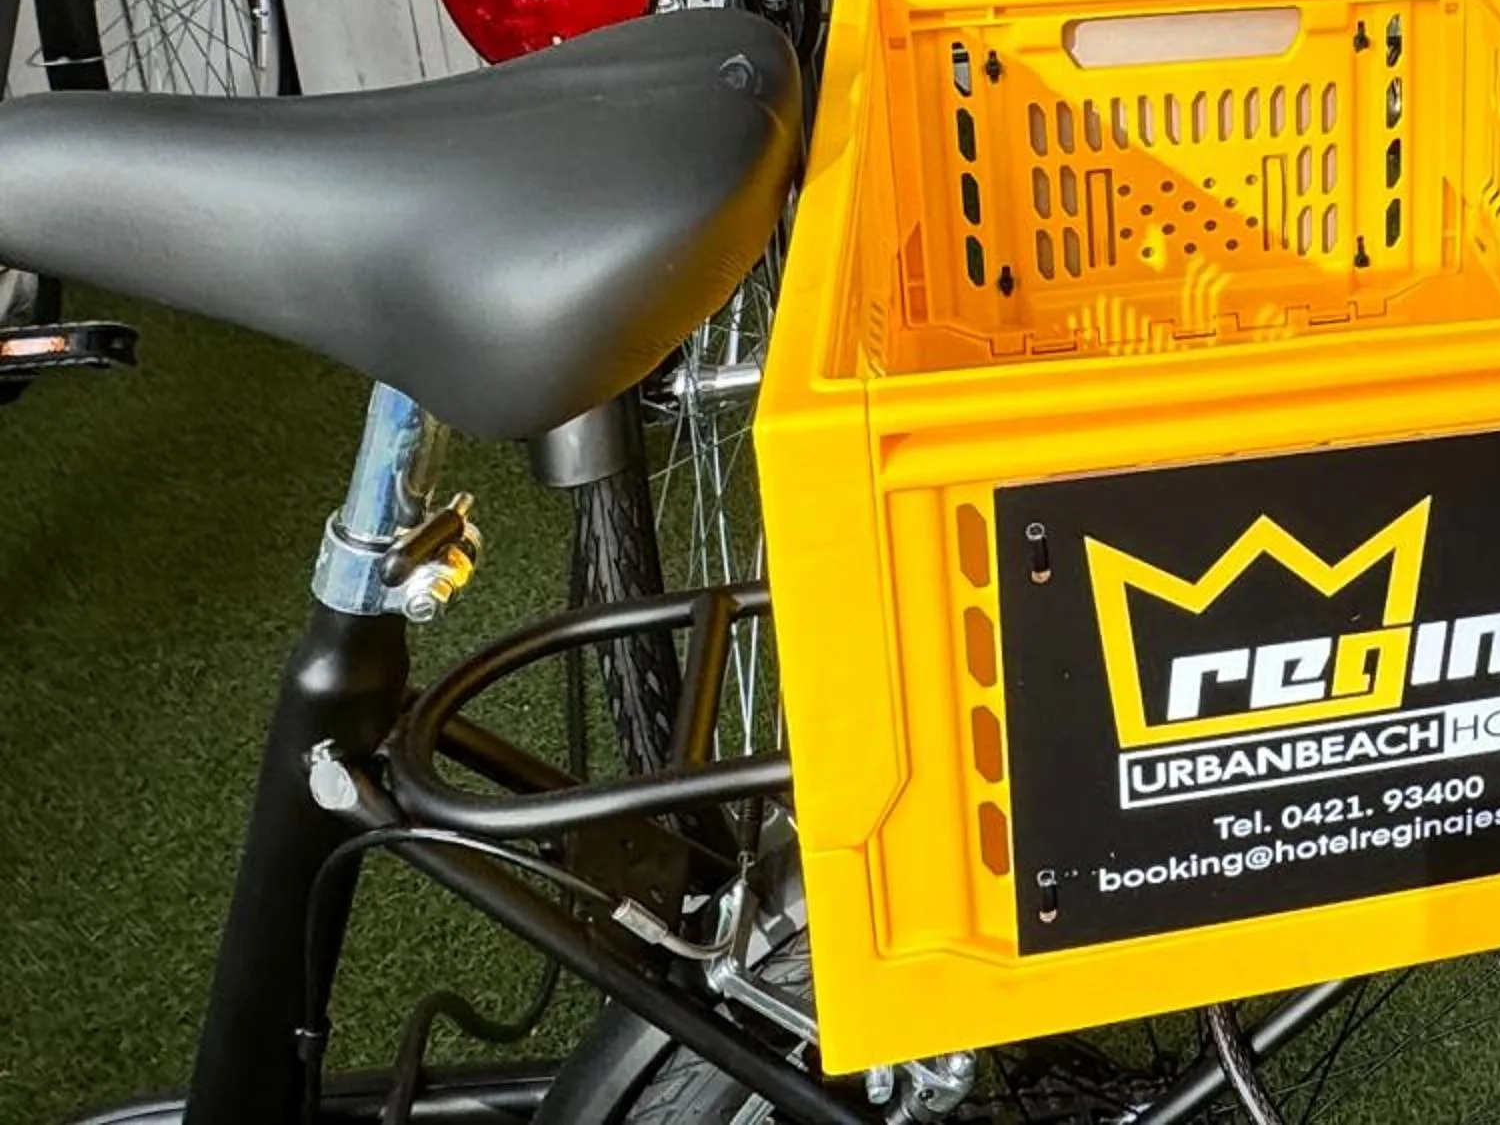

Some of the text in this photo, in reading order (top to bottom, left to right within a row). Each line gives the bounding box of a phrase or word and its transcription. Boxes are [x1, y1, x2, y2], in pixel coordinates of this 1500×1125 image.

[1132, 720, 1440, 794] URBANBEACH
[1214, 776, 1485, 841] Tel. 0421. 93400
